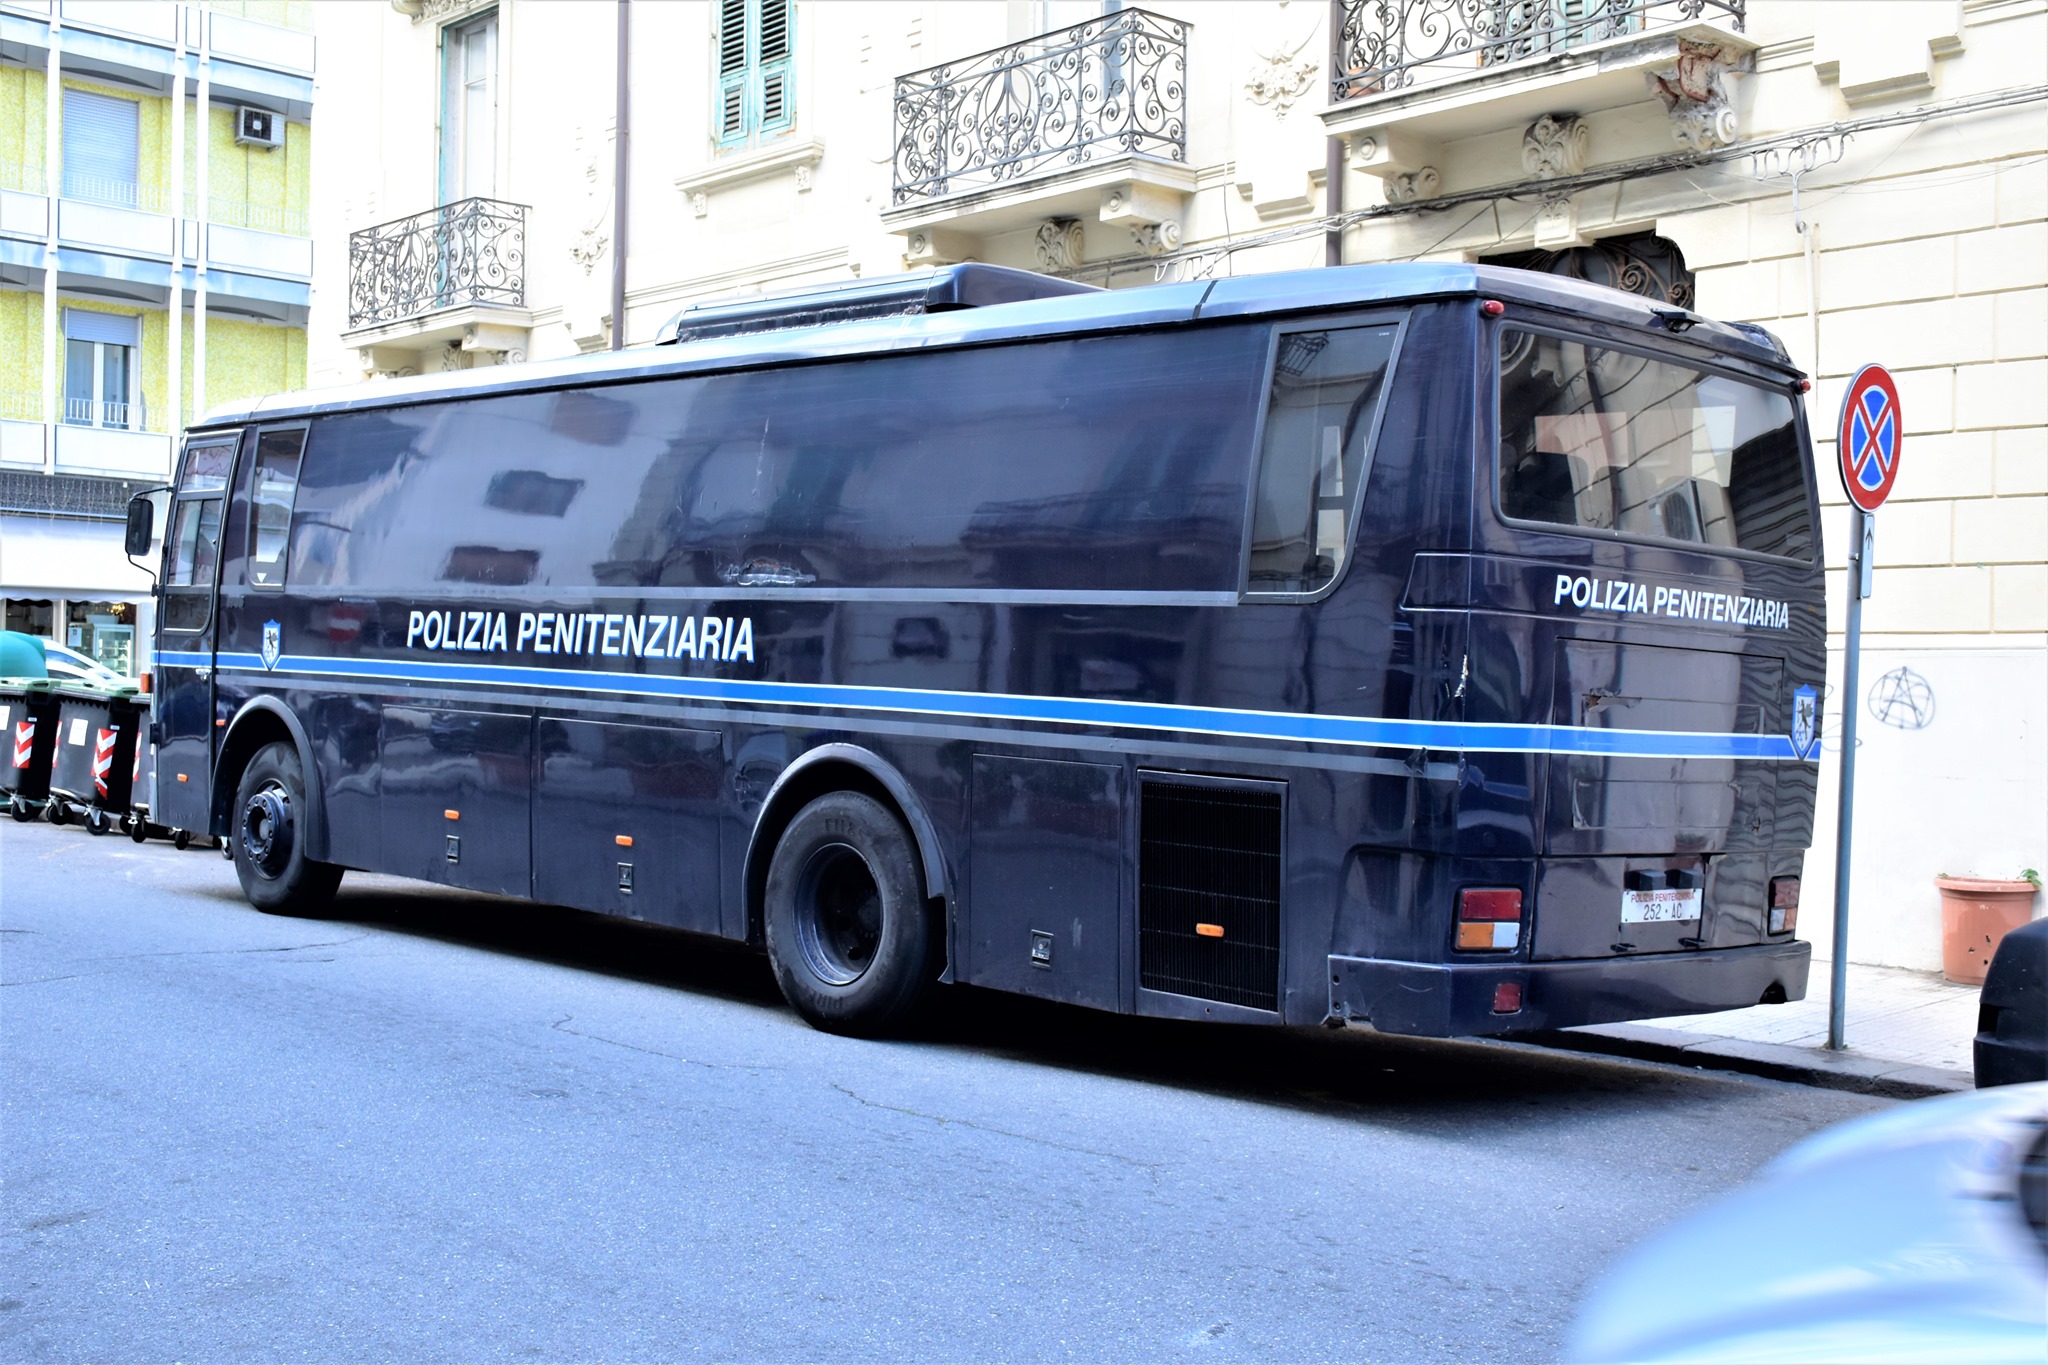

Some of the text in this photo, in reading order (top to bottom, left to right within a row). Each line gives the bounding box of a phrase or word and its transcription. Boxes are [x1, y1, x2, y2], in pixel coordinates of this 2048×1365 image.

[1553, 574, 1789, 629] POLIZIA PENITENZIARIA
[406, 610, 755, 663] POLIZIA PENITENZIARIA
[1630, 892, 1654, 903] POLIZIA
[1643, 903, 1661, 920] 252
